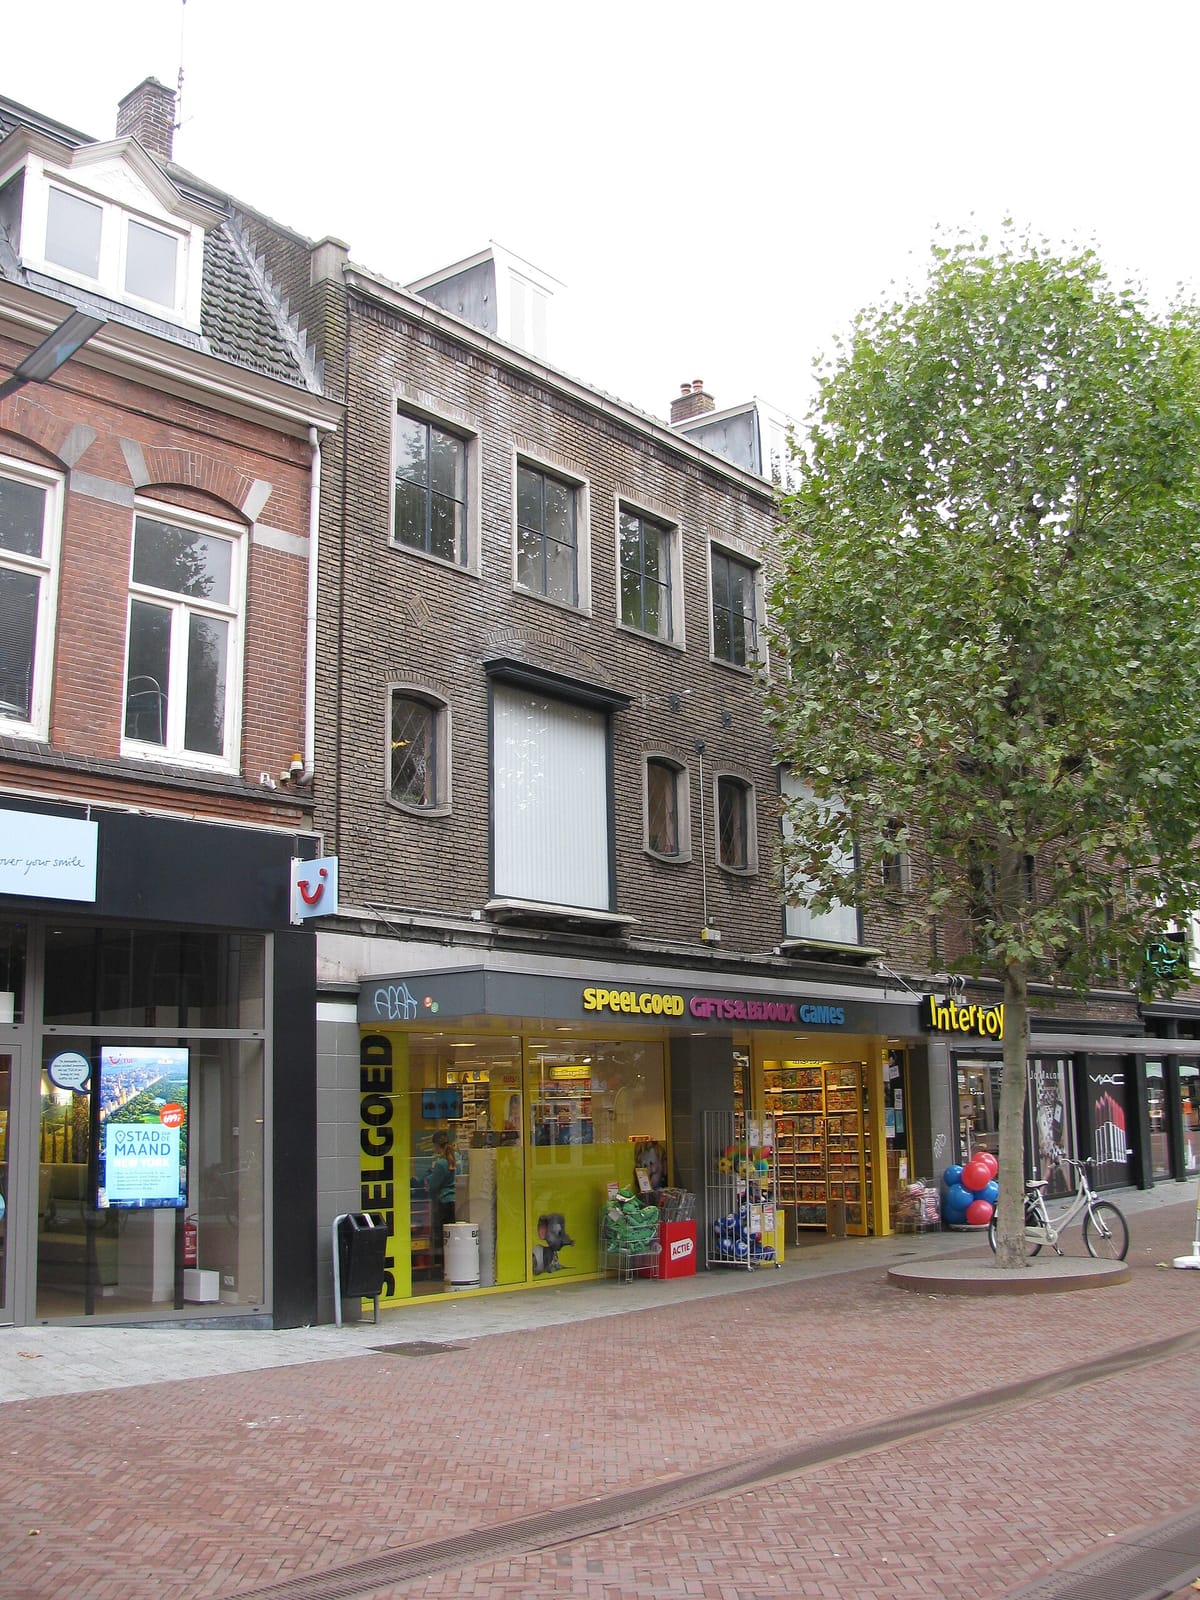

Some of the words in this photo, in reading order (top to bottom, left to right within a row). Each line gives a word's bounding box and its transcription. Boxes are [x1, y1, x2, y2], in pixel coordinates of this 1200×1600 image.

[24, 859, 51, 876] your
[52, 856, 86, 868] smile
[929, 994, 1006, 1041] Intertoy
[126, 1130, 161, 1142] STAD
[114, 1143, 171, 1157] MAAND
[672, 1242, 692, 1257] ACTIE
